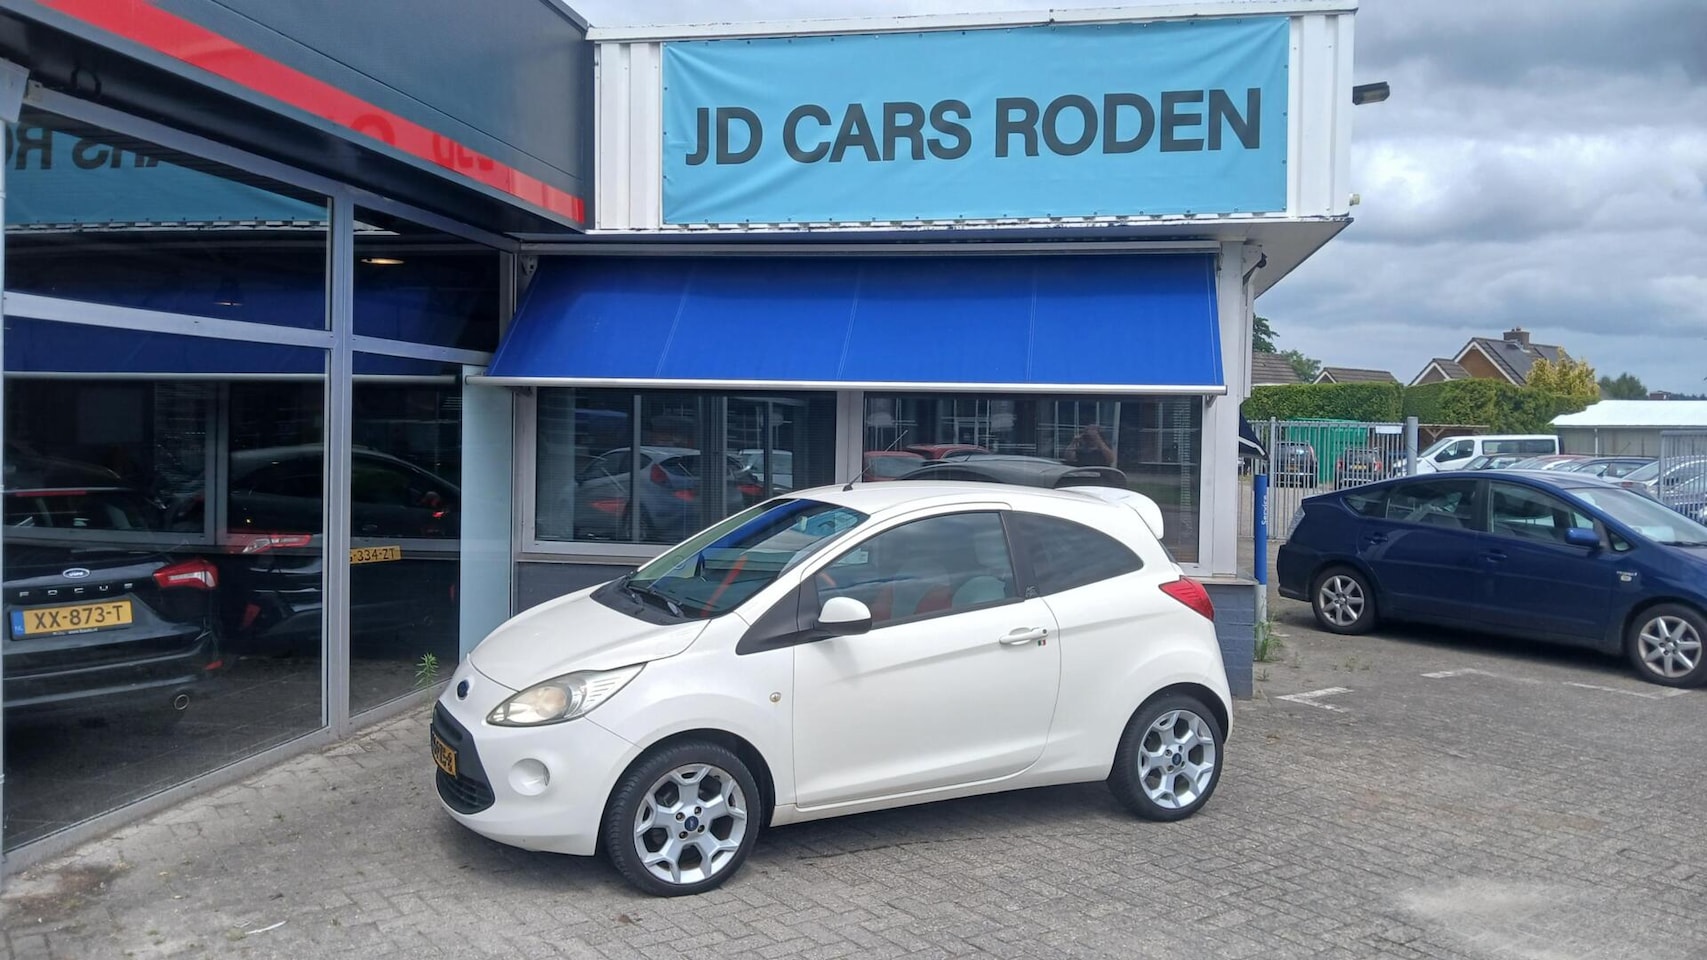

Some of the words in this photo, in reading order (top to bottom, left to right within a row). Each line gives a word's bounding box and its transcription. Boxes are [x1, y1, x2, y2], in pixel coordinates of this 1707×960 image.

[685, 106, 763, 166] JD
[783, 99, 972, 164] CARS
[995, 87, 1261, 158] RODEN
[350, 548, 395, 562] -334-ZT
[34, 605, 123, 630] XX-873-T
